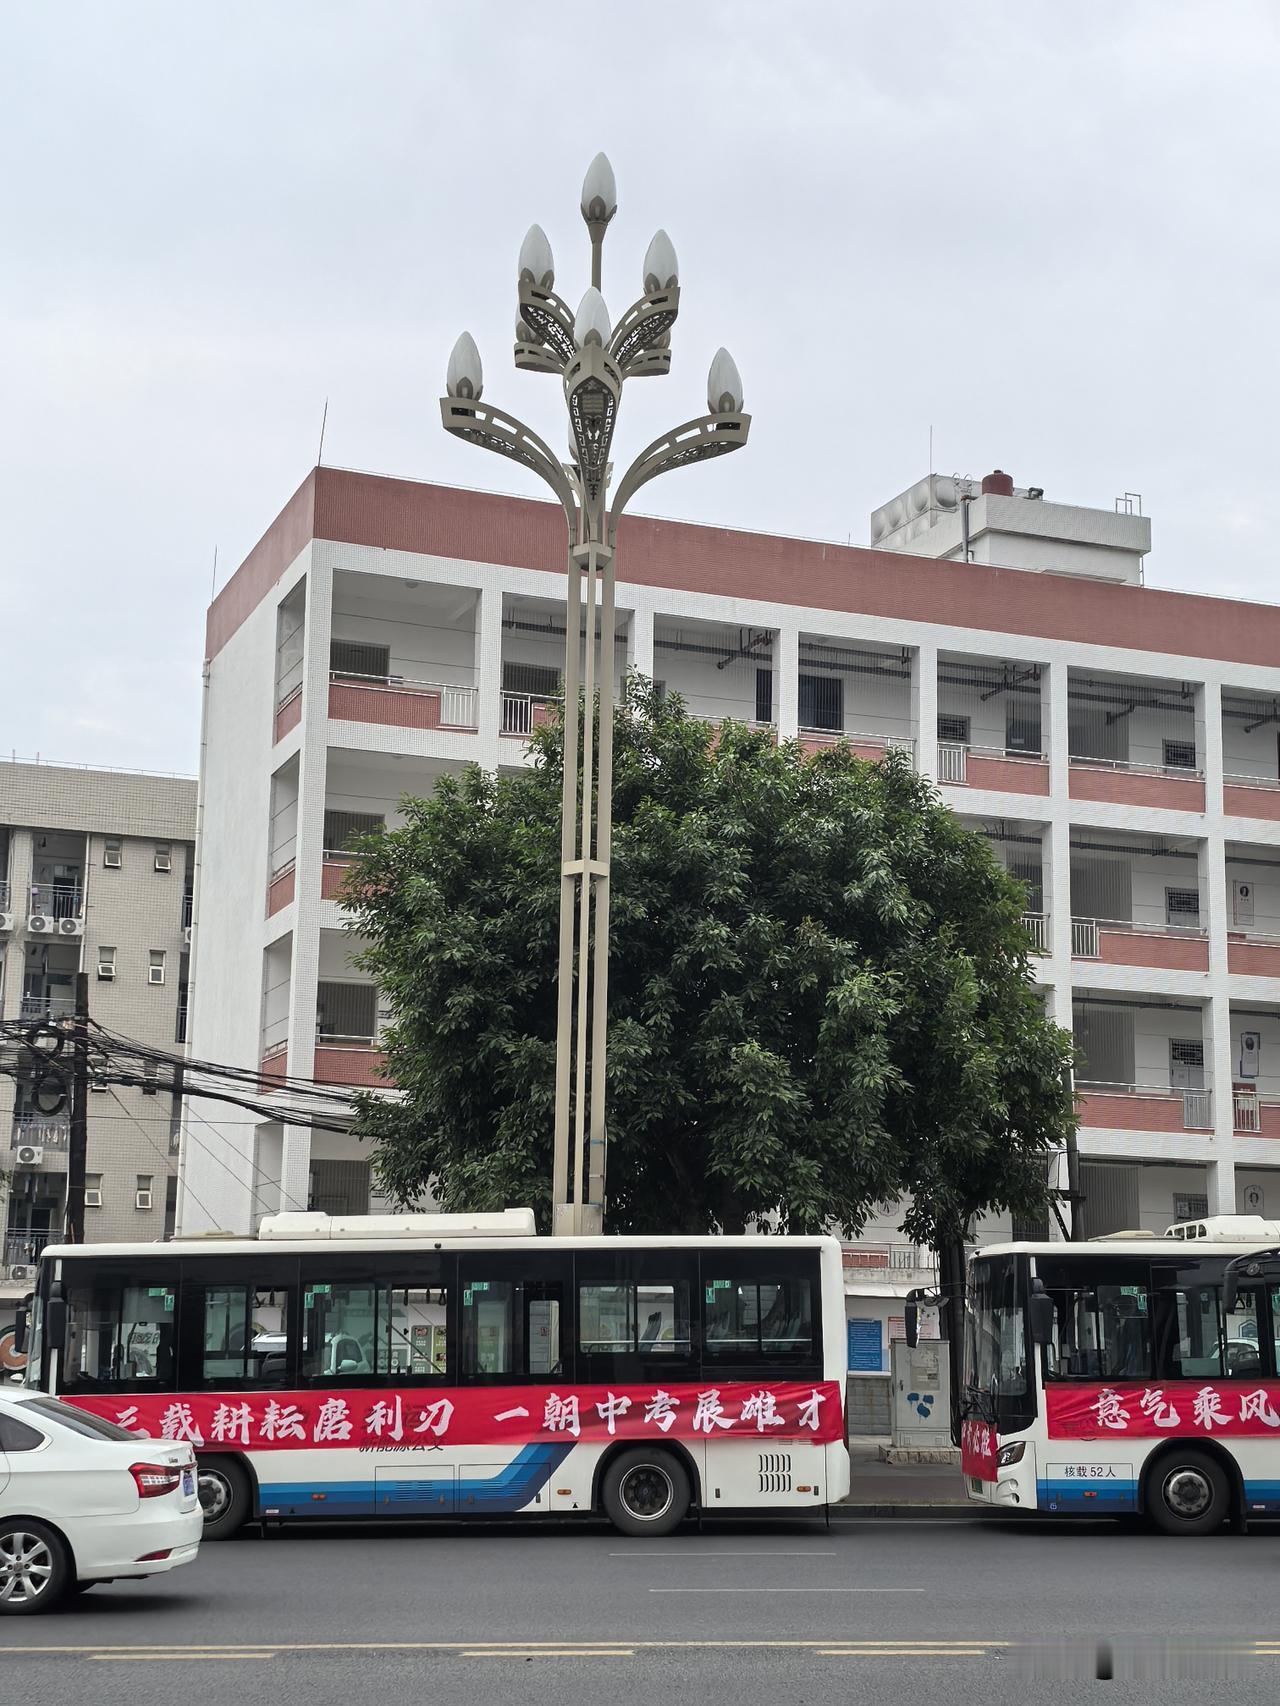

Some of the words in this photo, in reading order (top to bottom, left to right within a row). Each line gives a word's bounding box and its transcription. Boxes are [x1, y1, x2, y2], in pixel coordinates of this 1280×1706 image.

[493, 1388, 827, 1437] 一朝中考展雄才
[1090, 1386, 1280, 1430] 意气乘风
[1064, 1465, 1117, 1478] 核载52人
